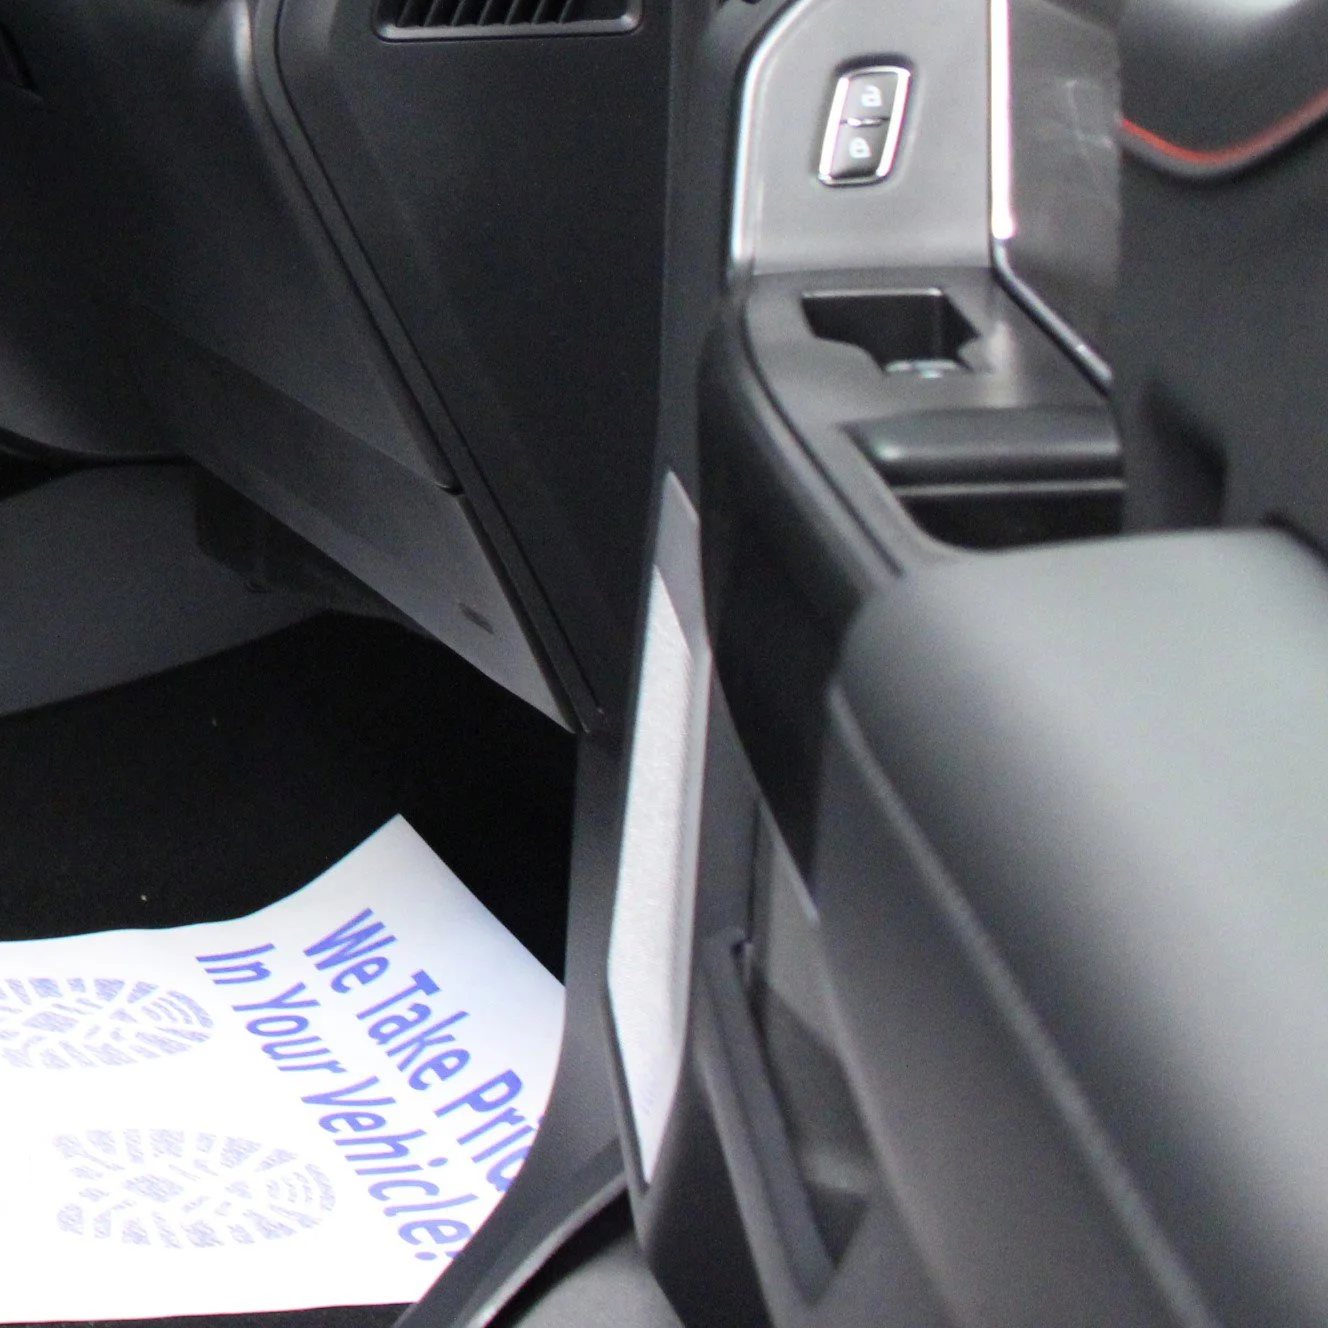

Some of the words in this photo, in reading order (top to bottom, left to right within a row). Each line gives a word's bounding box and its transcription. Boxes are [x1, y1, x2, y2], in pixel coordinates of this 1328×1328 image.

[196, 943, 276, 985] In
[303, 907, 398, 993] We
[356, 969, 471, 1091] Take
[232, 982, 348, 1072] Your
